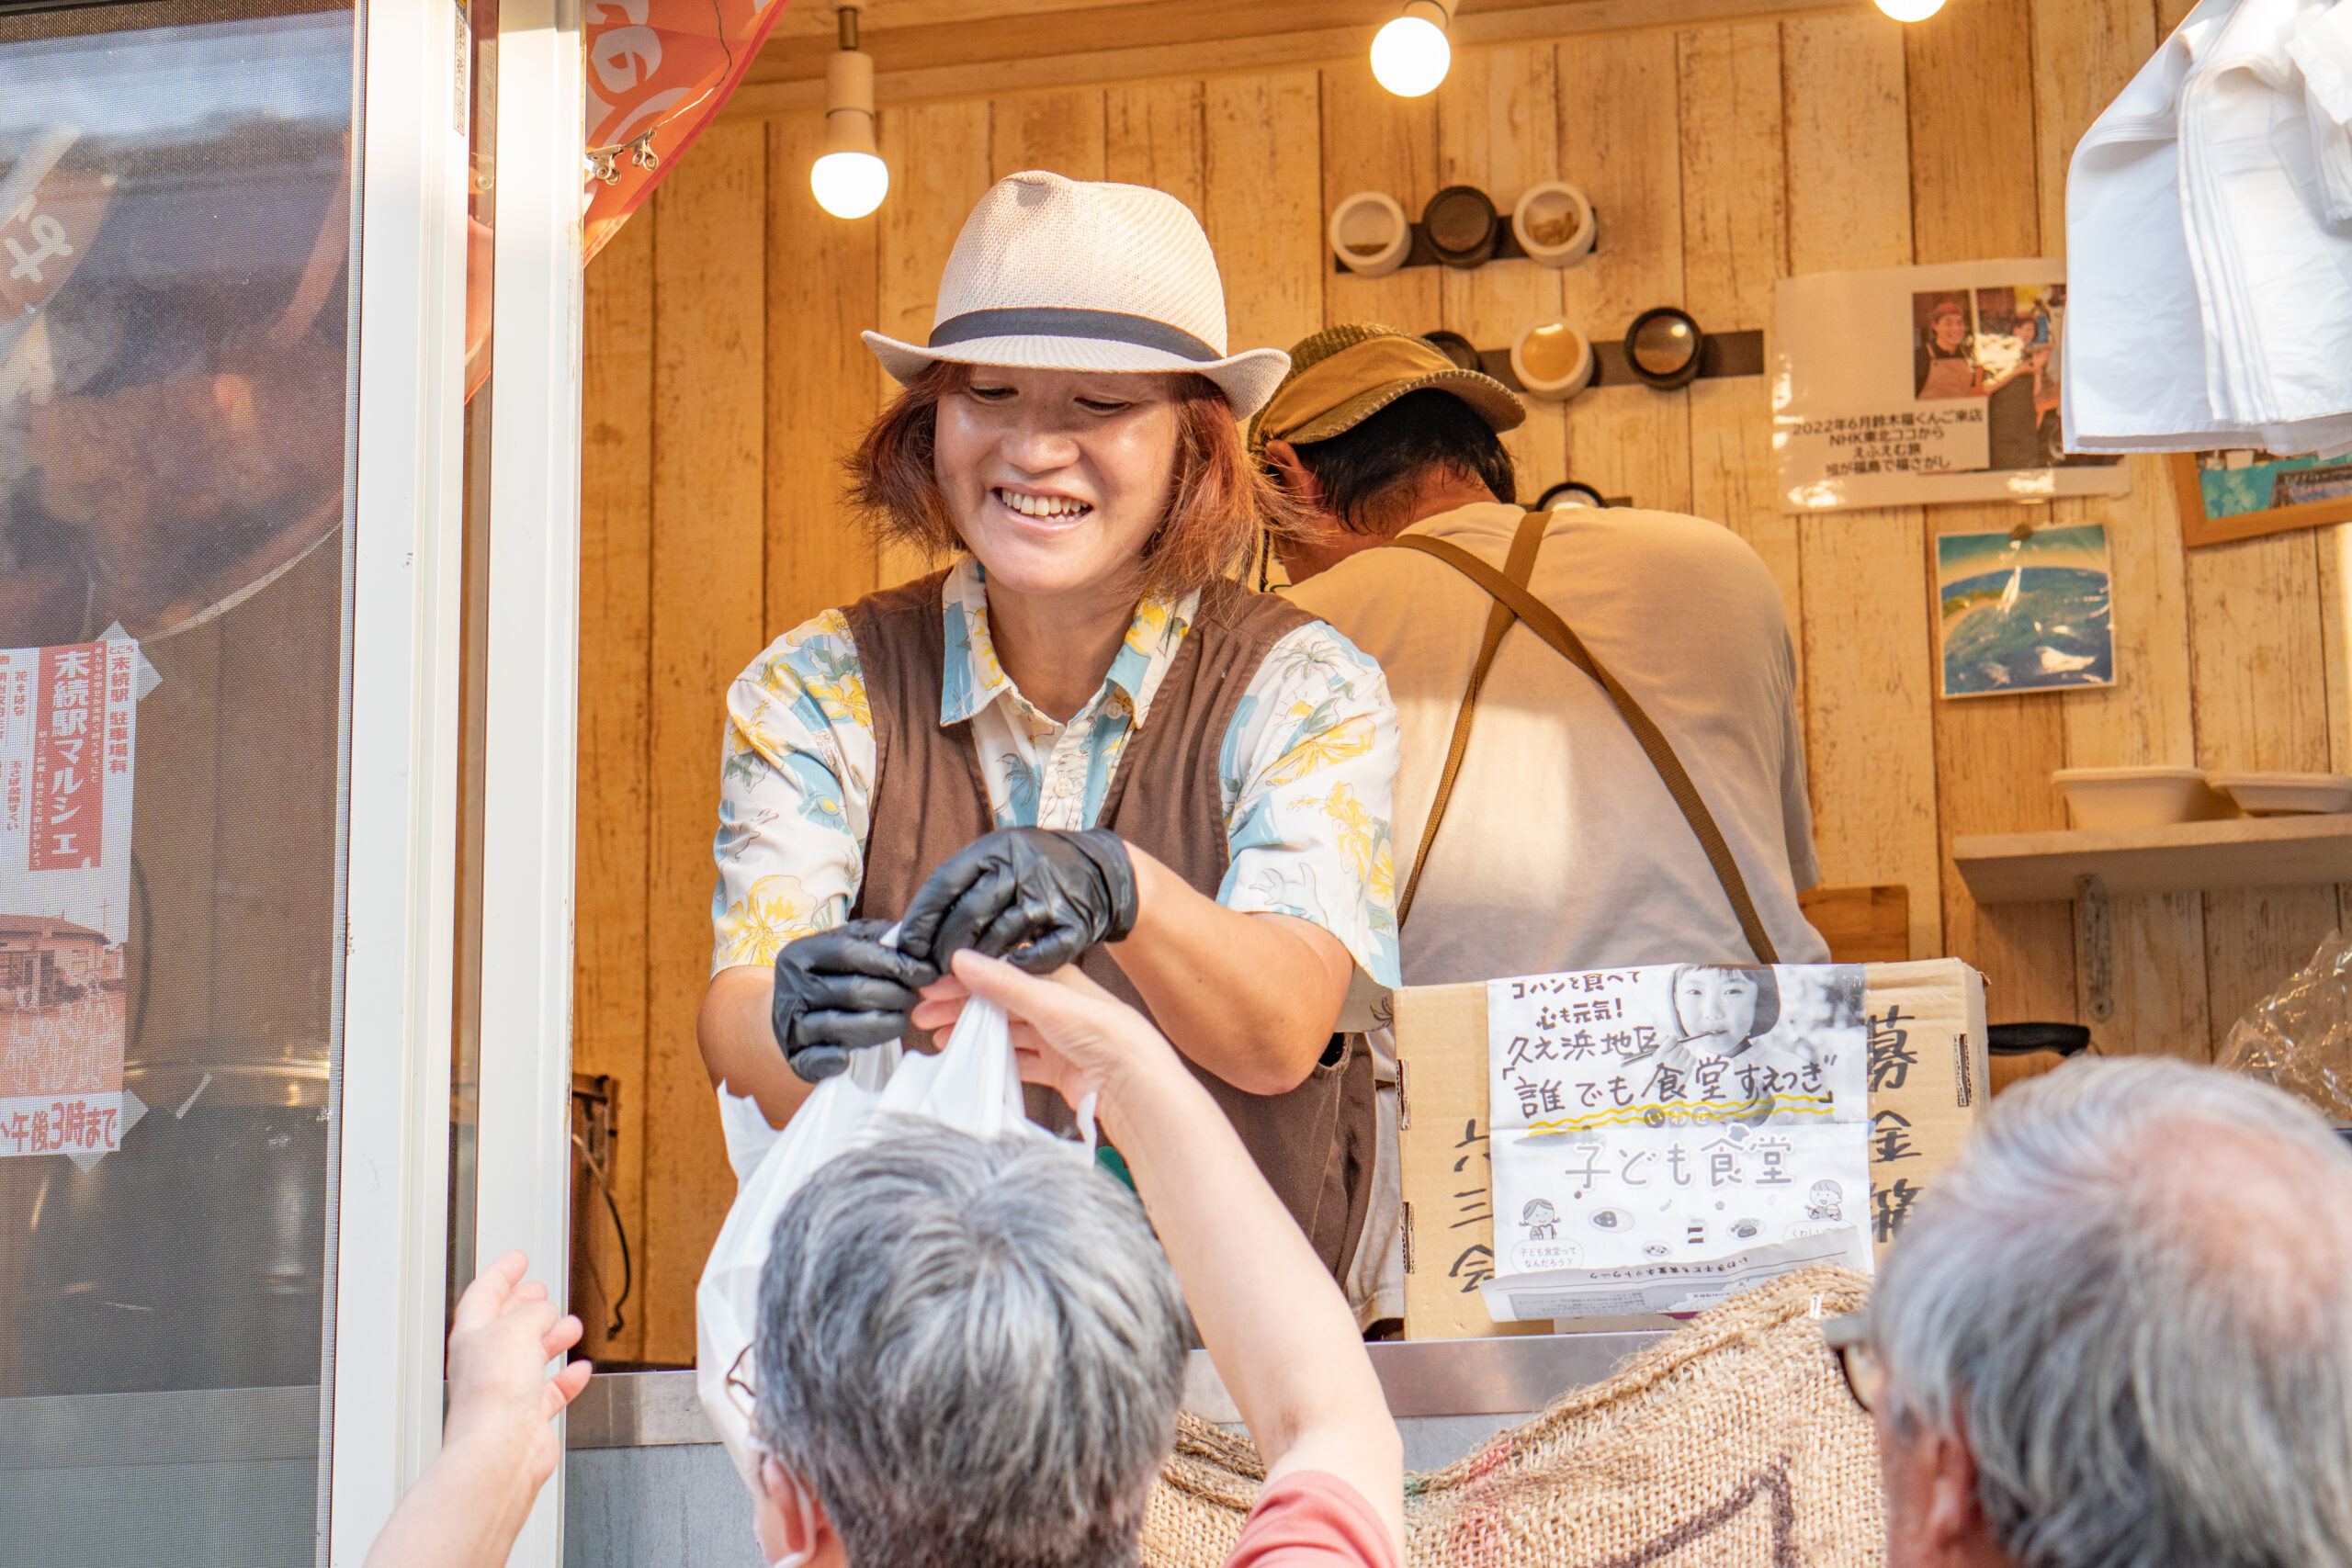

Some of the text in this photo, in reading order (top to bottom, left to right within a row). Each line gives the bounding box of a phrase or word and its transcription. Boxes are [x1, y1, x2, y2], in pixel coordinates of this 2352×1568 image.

[110, 657, 131, 704] 末続駅
[51, 651, 91, 855] 末続駅マルシェ
[11, 1100, 118, 1152] 午後3時まで
[1565, 1135, 1792, 1188] 子ども食堂
